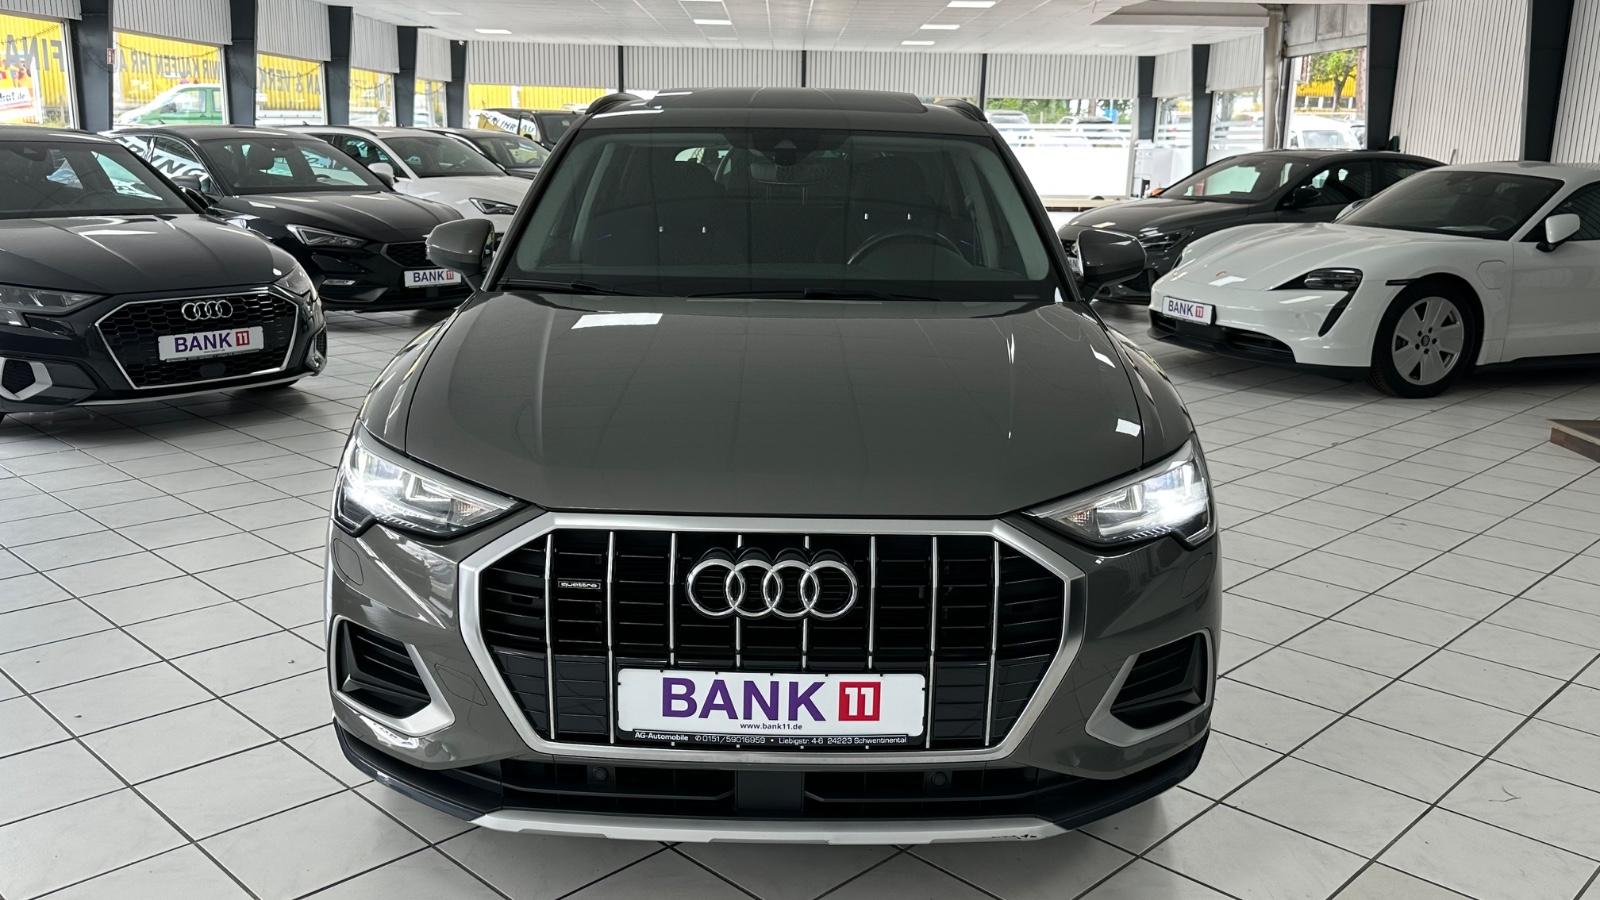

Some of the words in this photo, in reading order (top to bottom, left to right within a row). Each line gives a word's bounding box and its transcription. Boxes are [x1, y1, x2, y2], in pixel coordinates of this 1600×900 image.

[413, 271, 445, 282] BANK
[1168, 300, 1194, 317] BANK
[174, 332, 232, 353] BANK
[237, 332, 248, 345] 11
[662, 677, 826, 722] BANK
[843, 685, 875, 717] 11
[739, 722, 803, 731] www.bank11.de
[634, 731, 689, 741] AG-Automobile
[853, 736, 907, 744] Schwentinental
